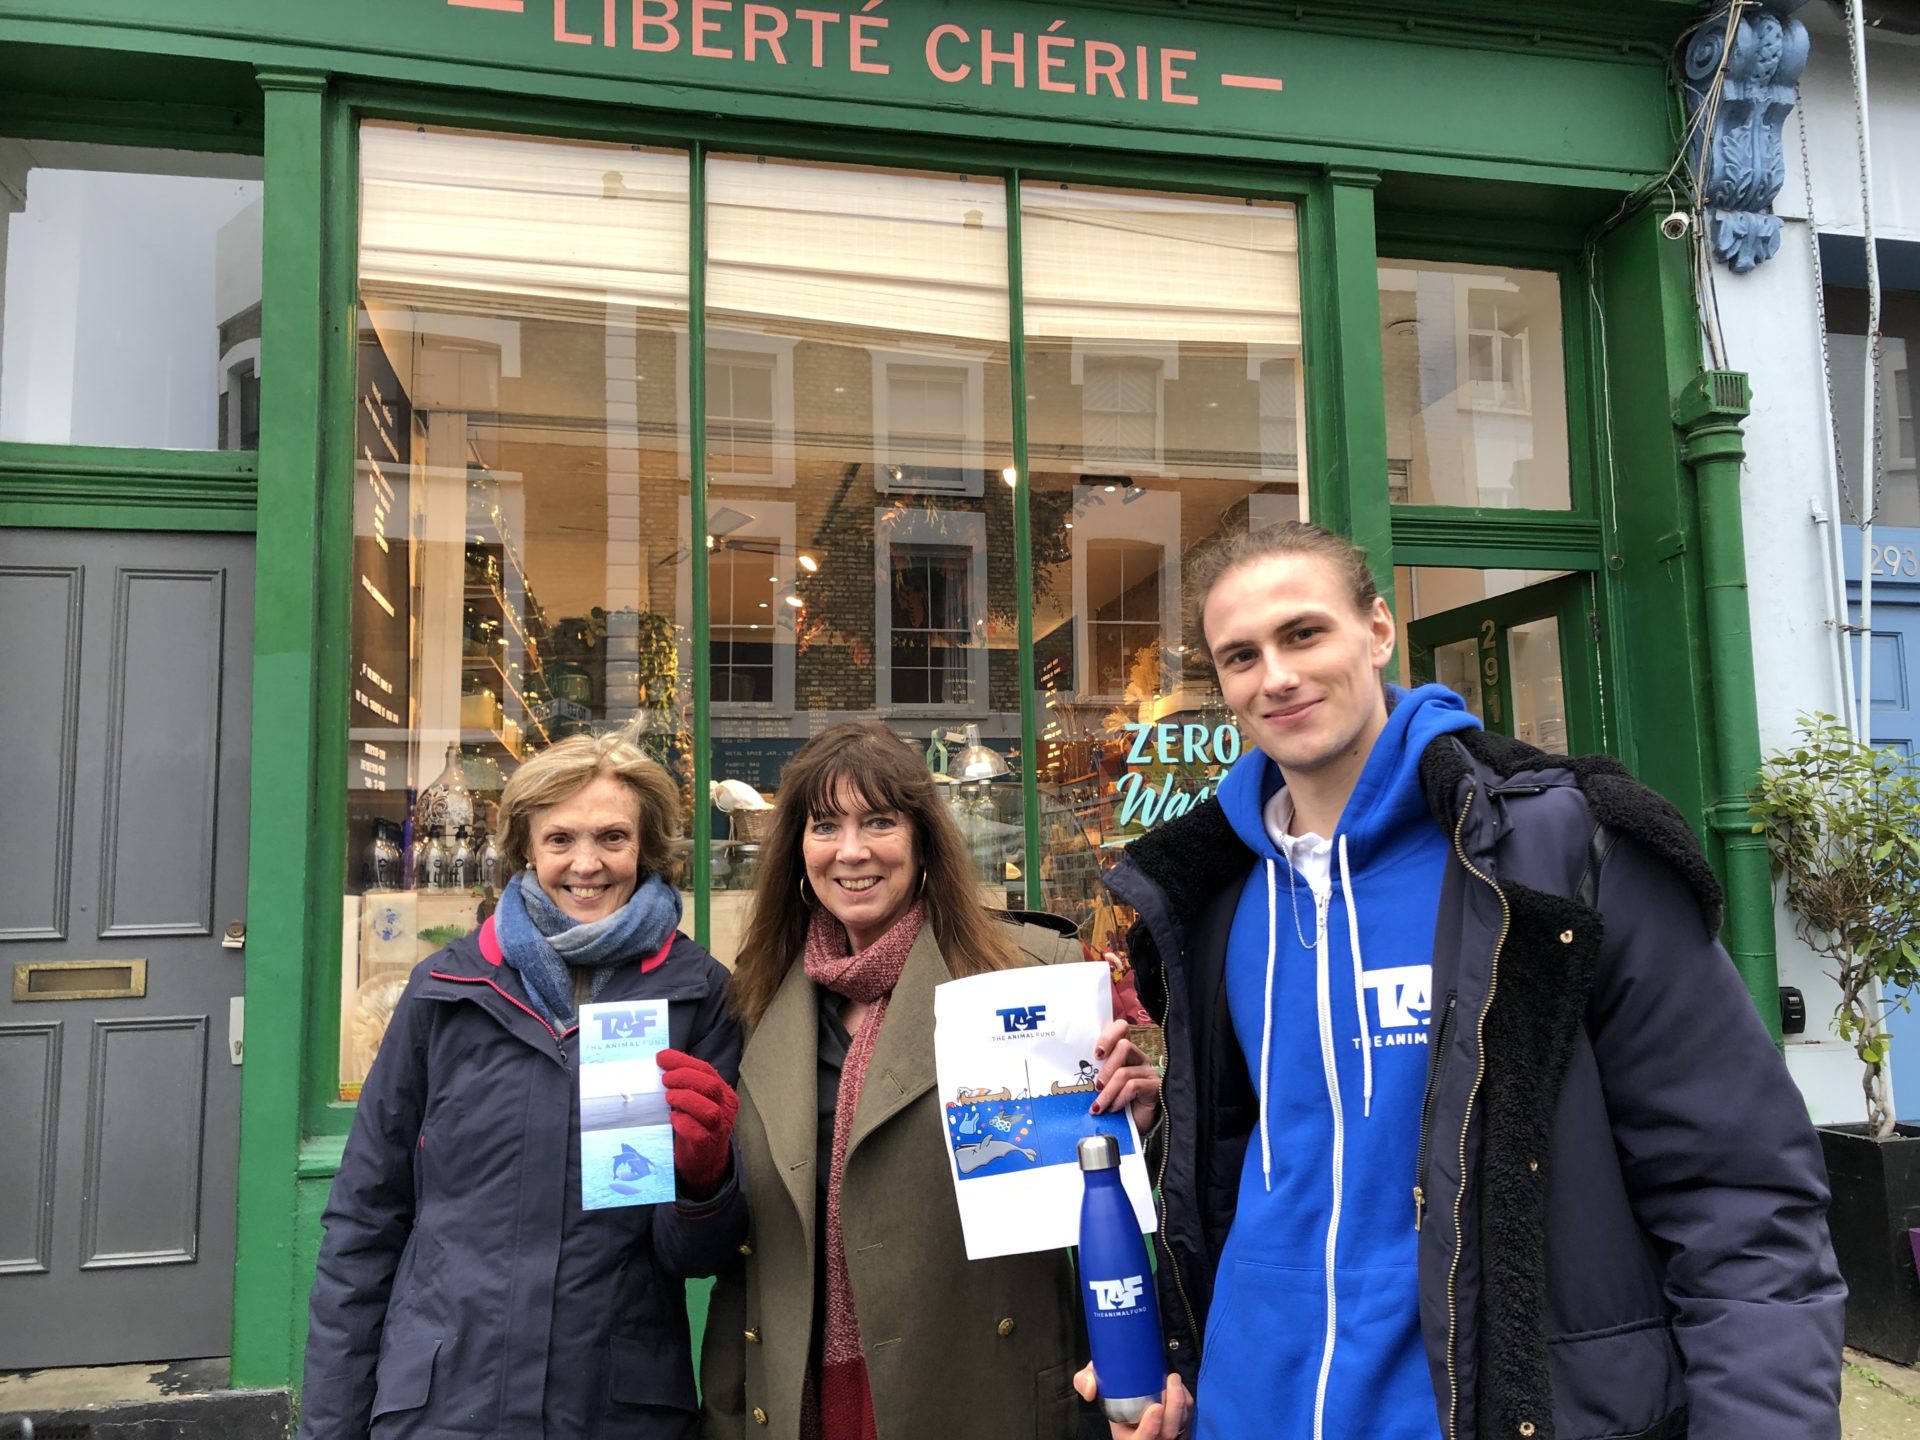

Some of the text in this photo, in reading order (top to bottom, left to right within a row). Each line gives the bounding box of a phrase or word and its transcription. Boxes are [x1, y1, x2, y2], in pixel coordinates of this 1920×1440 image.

[552, 0, 1200, 106] LIBERTÉ CHÉRIE
[1871, 544, 1918, 577] 293
[1481, 619, 1500, 723] 291
[1123, 722, 1242, 764] ZERO
[1362, 964, 1433, 1029] TA
[593, 1008, 658, 1041] TAF
[996, 1005, 1047, 1033] TAF
[605, 1041, 640, 1049] ANIMAL
[1385, 1033, 1429, 1046] ANIM
[1089, 1275, 1144, 1310] TAF
